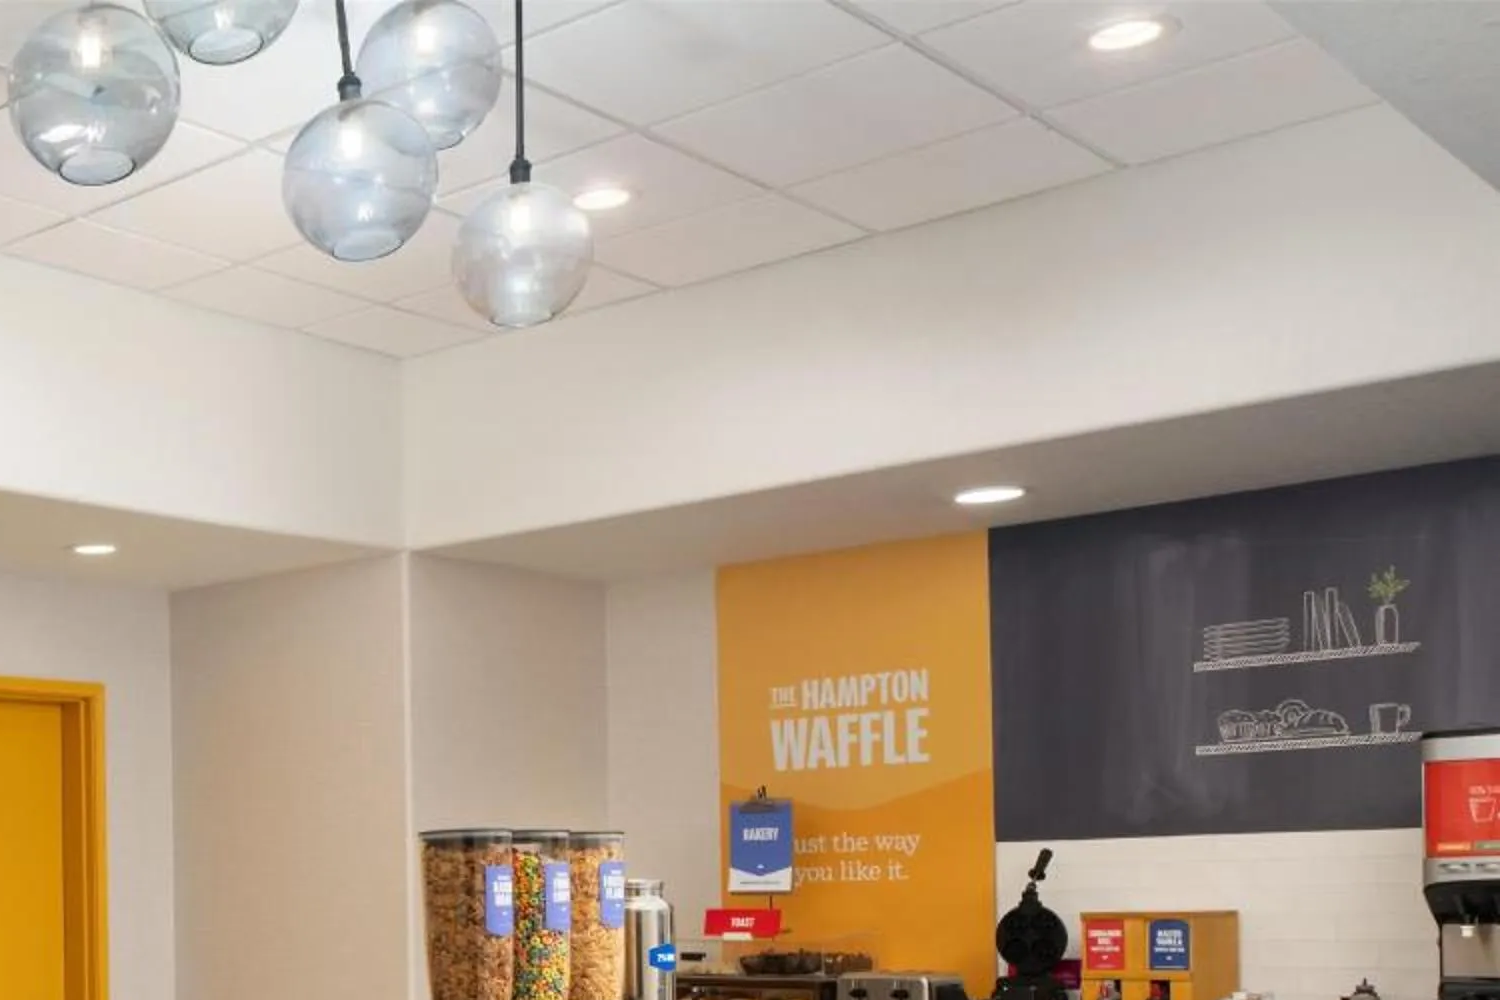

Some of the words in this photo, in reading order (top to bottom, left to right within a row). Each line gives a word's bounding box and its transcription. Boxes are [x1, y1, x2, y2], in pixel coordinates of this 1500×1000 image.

[769, 686, 797, 706] THE
[802, 668, 928, 711] HAMPTON
[770, 707, 931, 772] WAFFLE
[743, 827, 779, 841] BAKERY
[833, 832, 869, 853] the
[874, 834, 920, 856] way
[794, 867, 833, 888] you
[840, 860, 882, 881] like
[887, 860, 911, 881] it.
